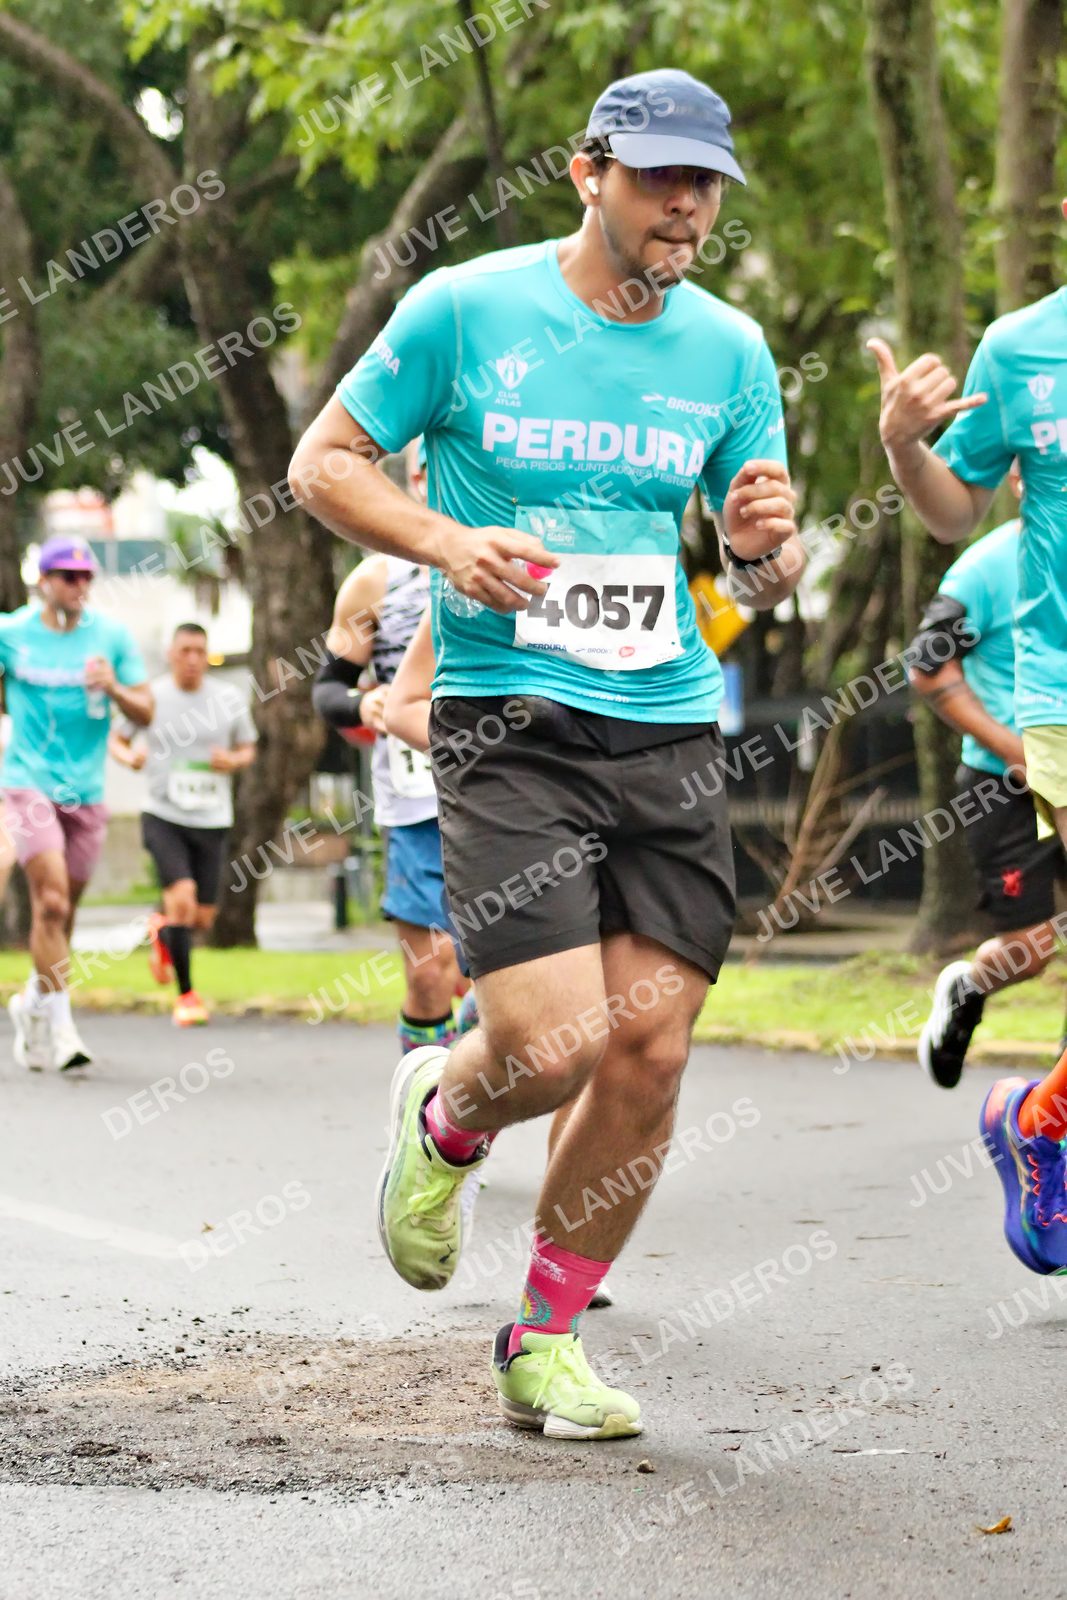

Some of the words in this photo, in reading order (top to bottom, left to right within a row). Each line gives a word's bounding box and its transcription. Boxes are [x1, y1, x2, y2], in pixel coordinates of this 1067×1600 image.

[666, 396, 721, 417] BROOKS
[482, 411, 705, 478] PERDURA
[496, 456, 529, 470] PEGA
[530, 460, 566, 472] PISOS
[574, 464, 653, 478] JUNTEADORES
[527, 583, 665, 631] 4057
